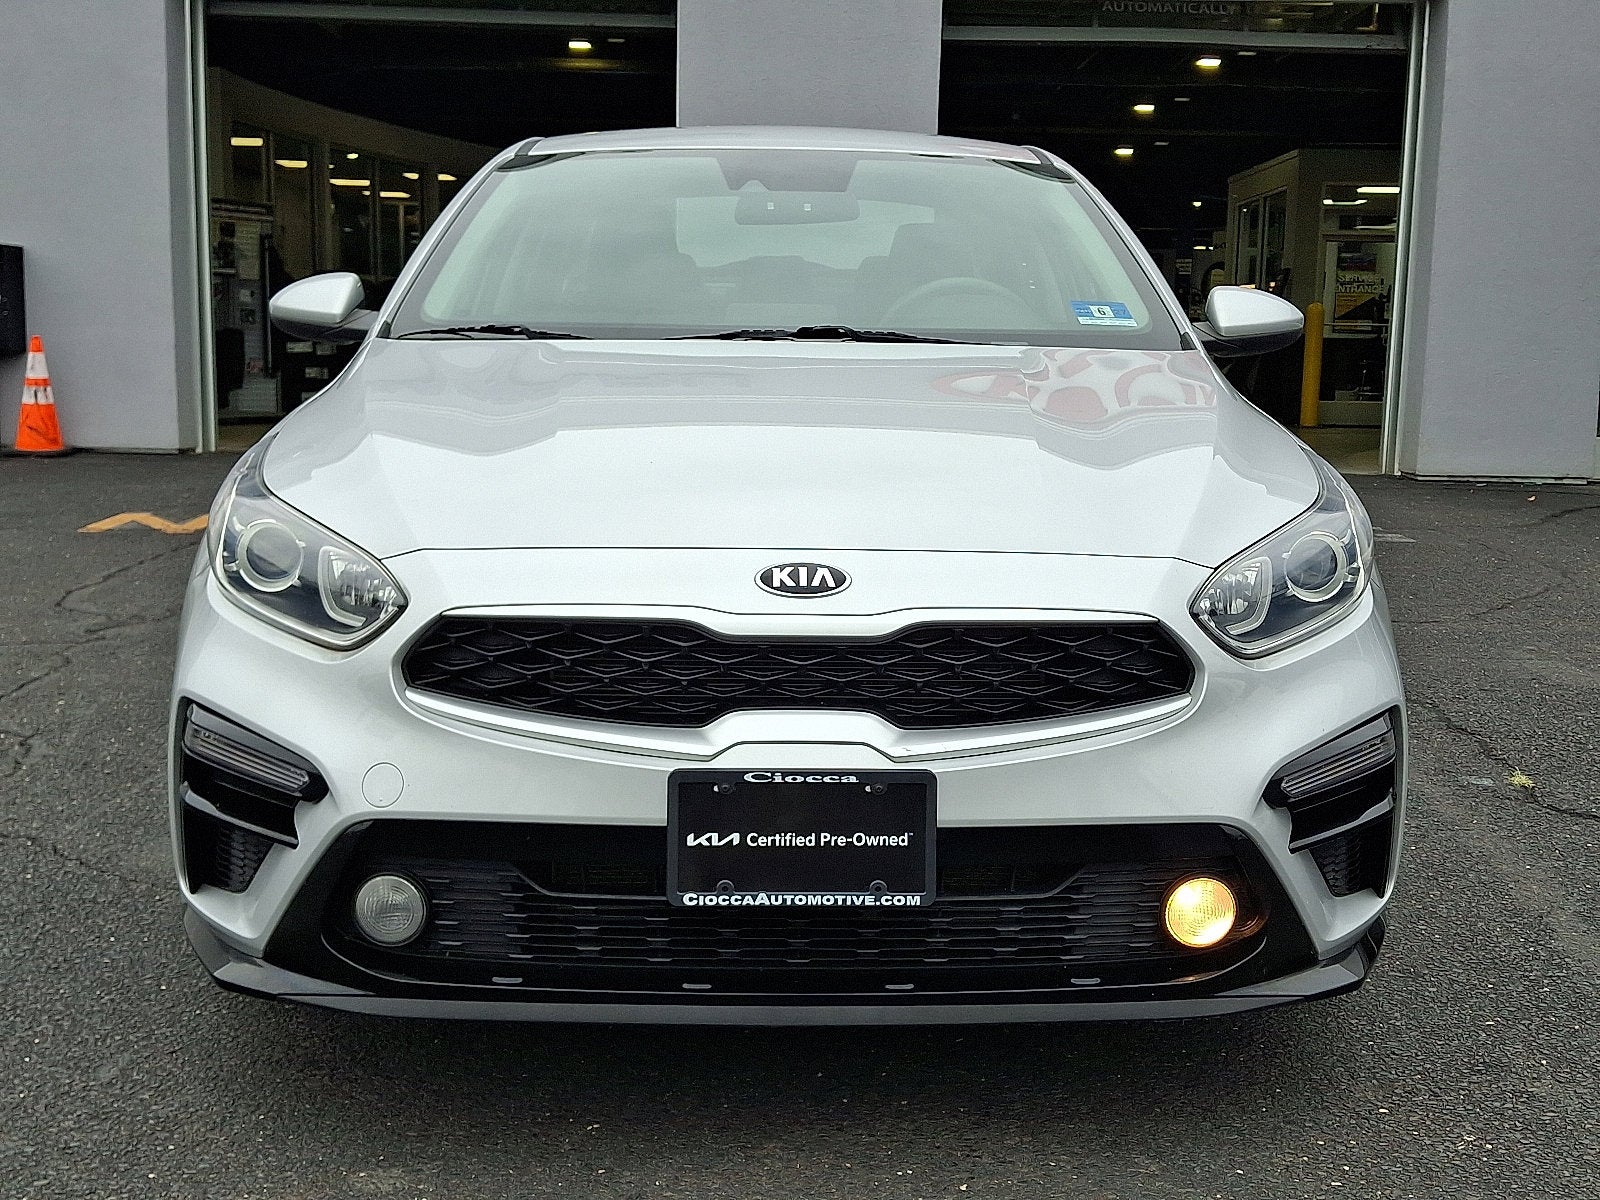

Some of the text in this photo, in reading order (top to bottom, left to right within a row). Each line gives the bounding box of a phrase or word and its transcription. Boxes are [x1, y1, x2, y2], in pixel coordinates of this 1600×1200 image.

[771, 566, 836, 588] KIA
[743, 772, 859, 783] Ciocca
[686, 832, 740, 847] KIA
[746, 832, 815, 847] Certified
